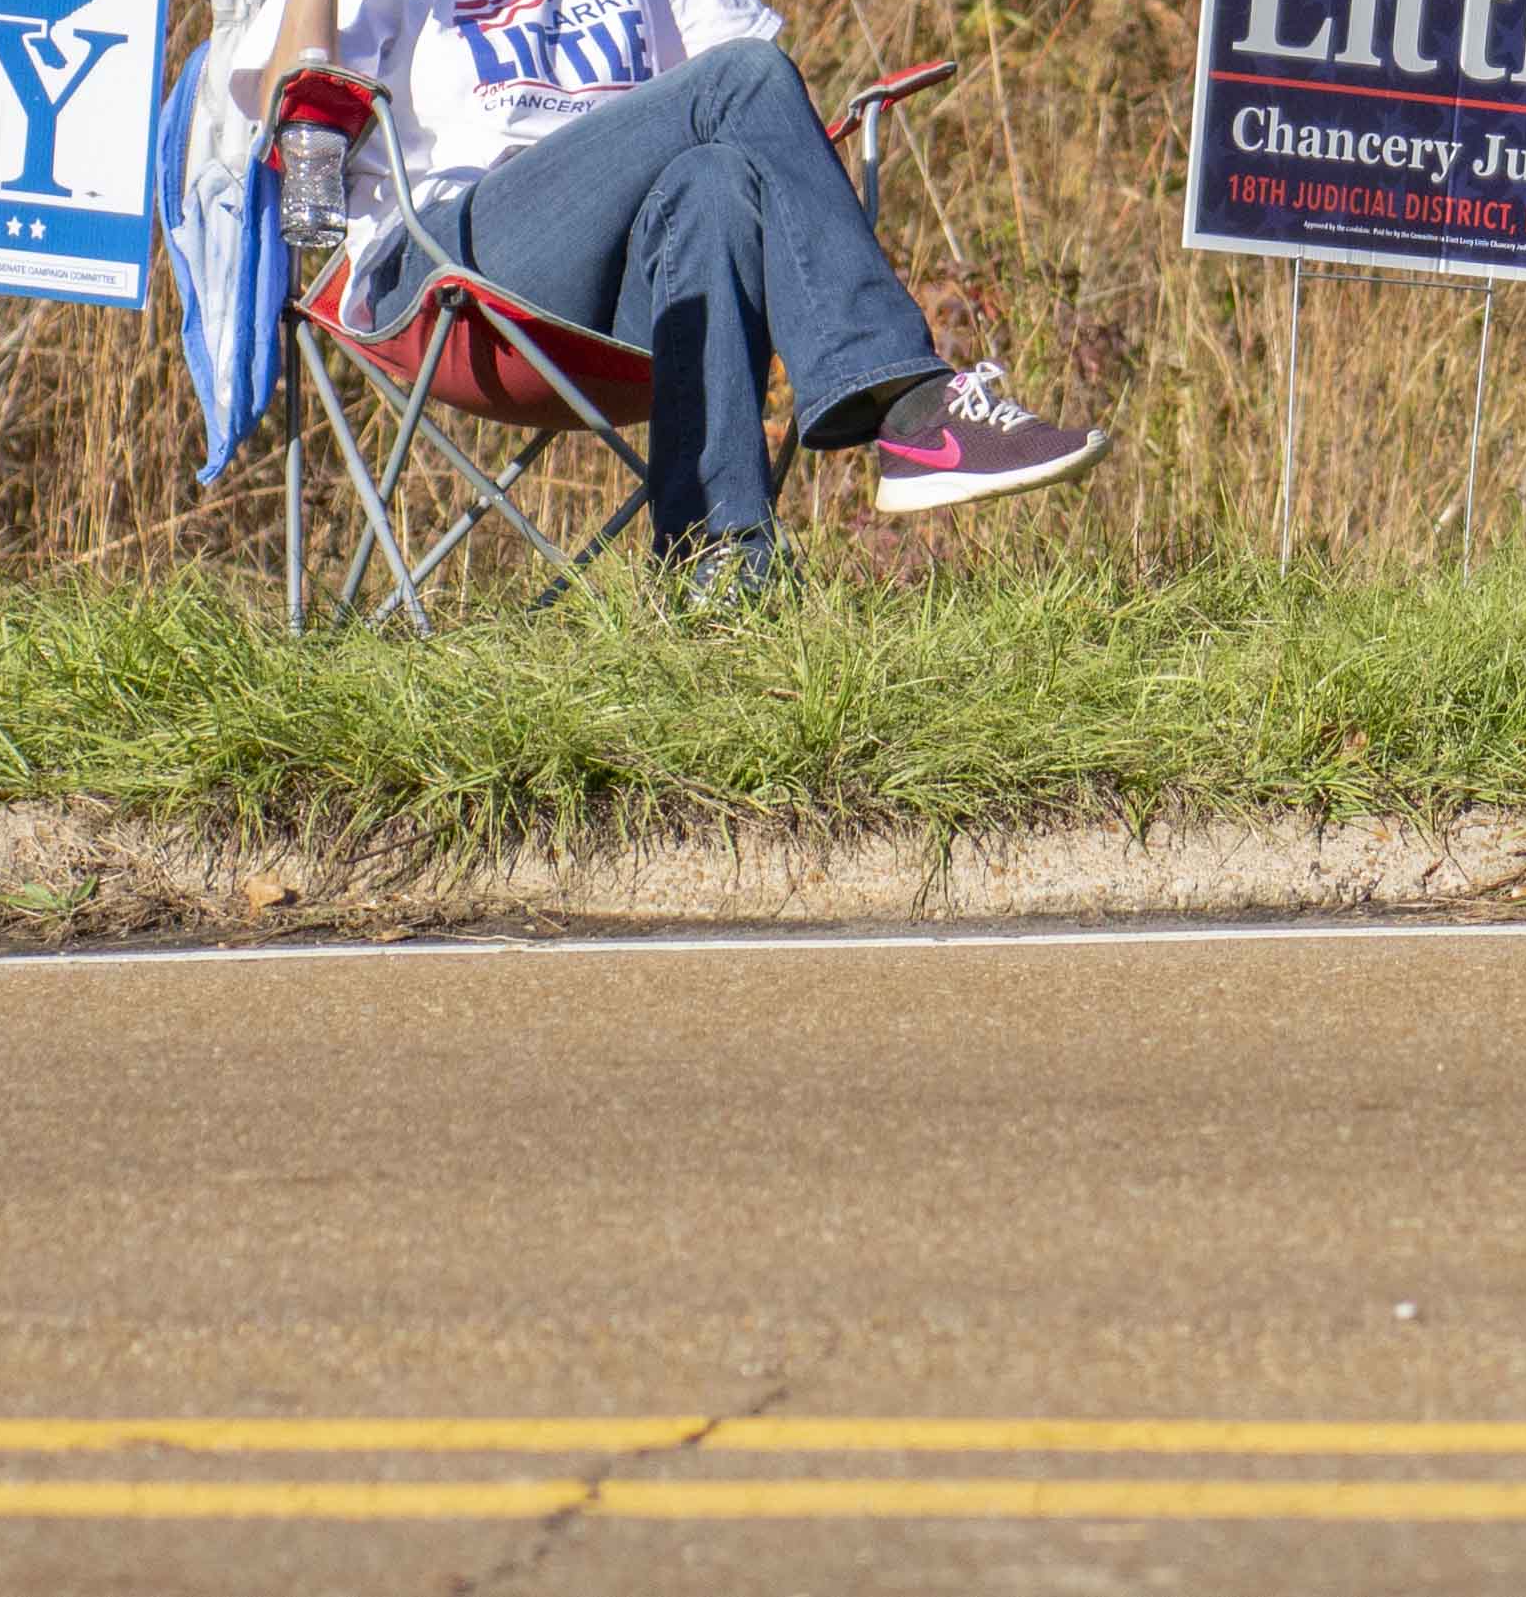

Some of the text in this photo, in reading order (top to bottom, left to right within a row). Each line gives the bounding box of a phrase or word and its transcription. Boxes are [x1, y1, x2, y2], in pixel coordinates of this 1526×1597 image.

[460, 9, 653, 85] LITTLE
[1231, 106, 1463, 184] Chancery
[1228, 174, 1286, 207] 18TH
[1292, 181, 1399, 220] JUDICIAL
[1406, 195, 1517, 236] DISTRICT,
